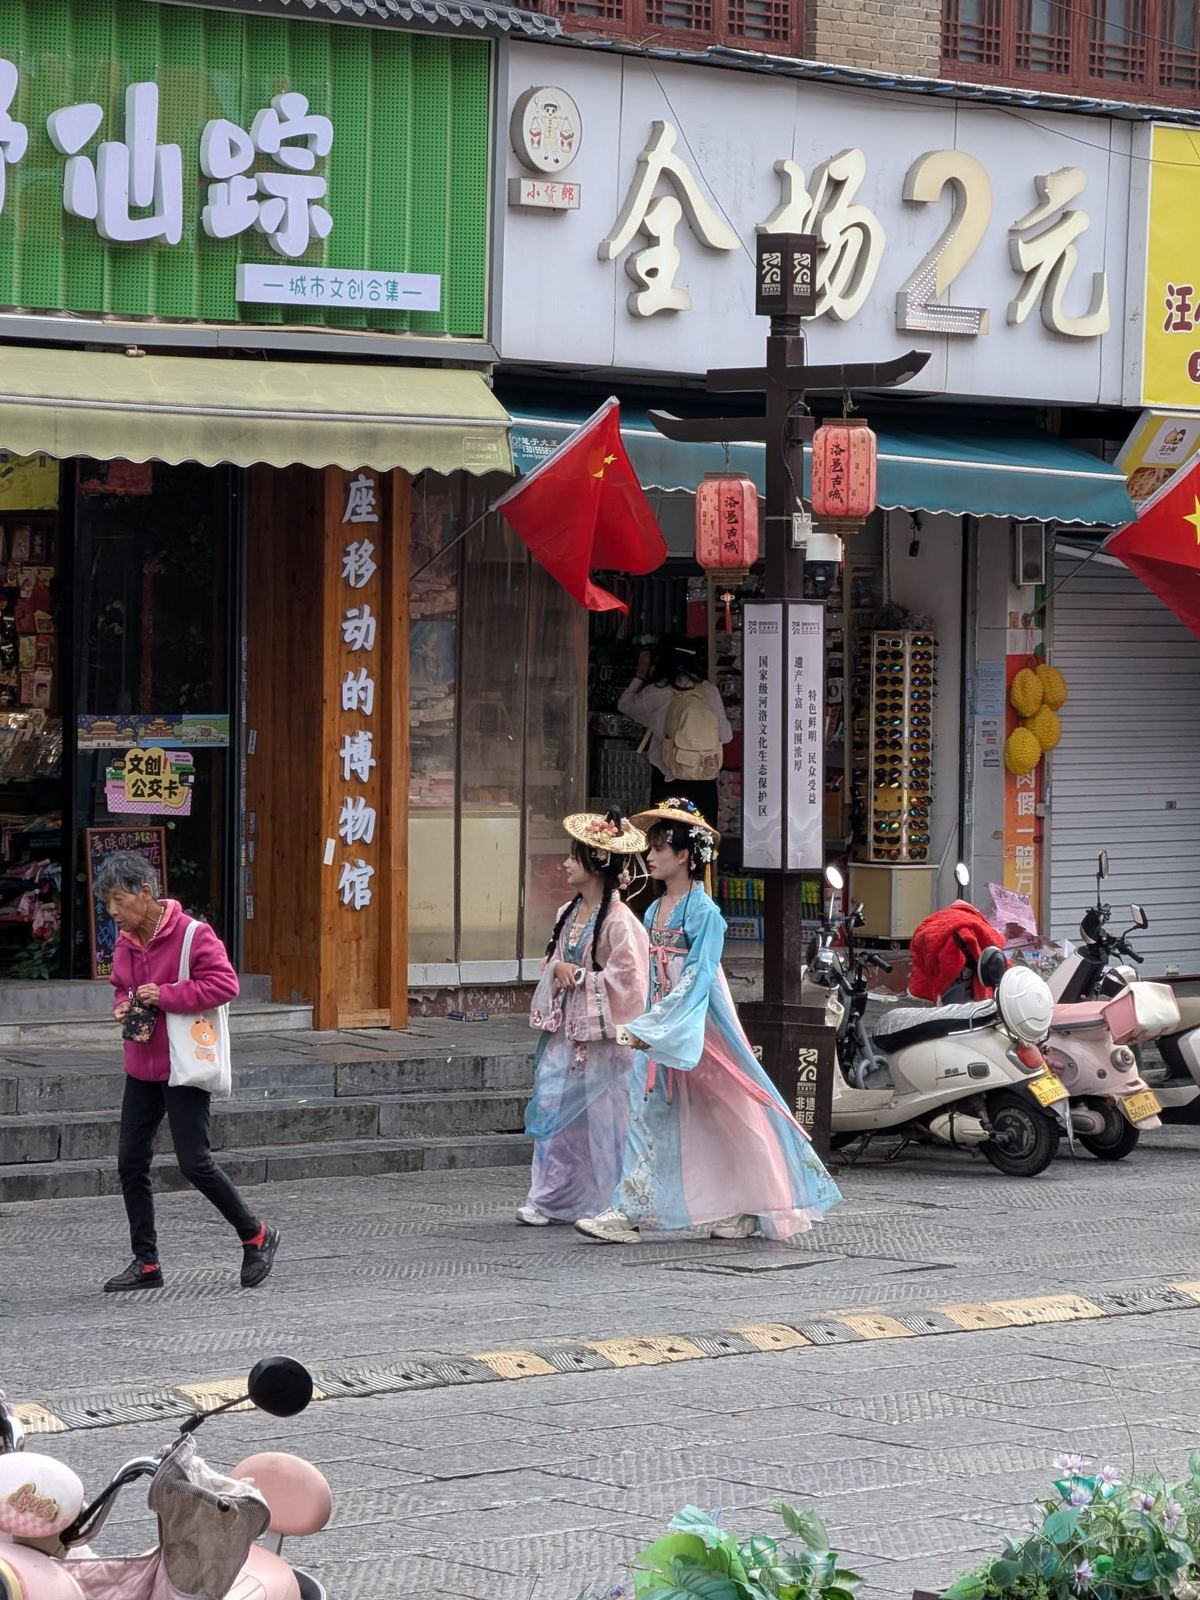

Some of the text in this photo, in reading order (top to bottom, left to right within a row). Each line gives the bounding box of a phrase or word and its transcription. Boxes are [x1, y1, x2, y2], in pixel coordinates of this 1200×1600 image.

[526, 183, 575, 205] 小货郎
[1164, 282, 1200, 334] 汪
[828, 443, 846, 506] 洛邑古城
[723, 496, 740, 555] 洛邑古城
[338, 473, 380, 912] 座移动的博物馆
[758, 655, 769, 817] 国家级河洛文化生态保护区
[807, 689, 818, 805] 特色鲜明 民众受益
[131, 778, 180, 799] 公交卡
